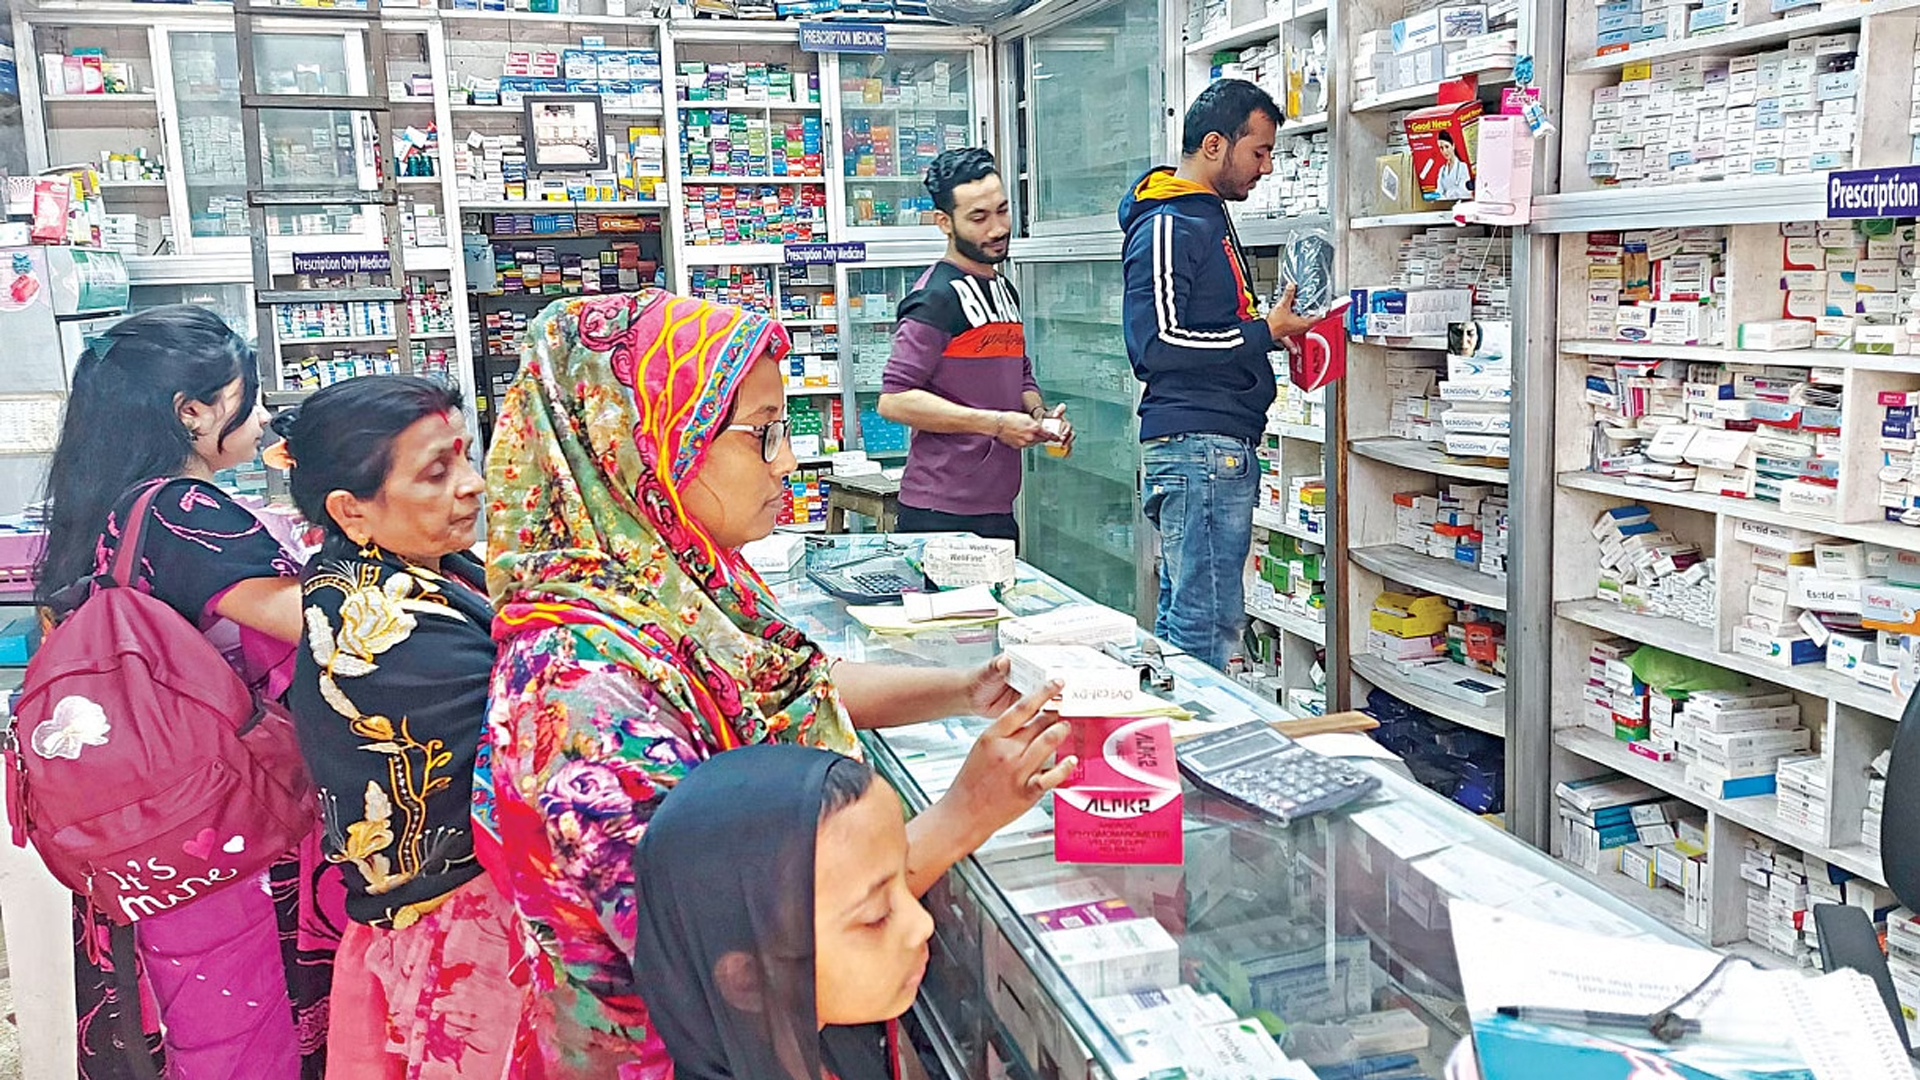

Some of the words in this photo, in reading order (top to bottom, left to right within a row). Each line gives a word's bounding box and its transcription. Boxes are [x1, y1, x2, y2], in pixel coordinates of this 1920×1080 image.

[803, 29, 851, 45] PRESCRIPTION
[852, 31, 883, 46] MEDICINE
[1411, 121, 1431, 132] Good
[1432, 119, 1452, 129] News
[1831, 173, 1919, 216] Prescription
[786, 247, 822, 263] Prescription
[823, 246, 837, 263] Only
[837, 245, 865, 259] Medicine
[294, 255, 340, 274] Prescription
[341, 255, 359, 273] Only
[359, 254, 391, 270] Medicin
[1442, 388, 1480, 396] SENSODYNE
[1444, 419, 1484, 428] SENSODYNE
[1449, 442, 1488, 451] SENSODYNE
[1085, 797, 1151, 813] ALPK2
[117, 868, 238, 922] mine
